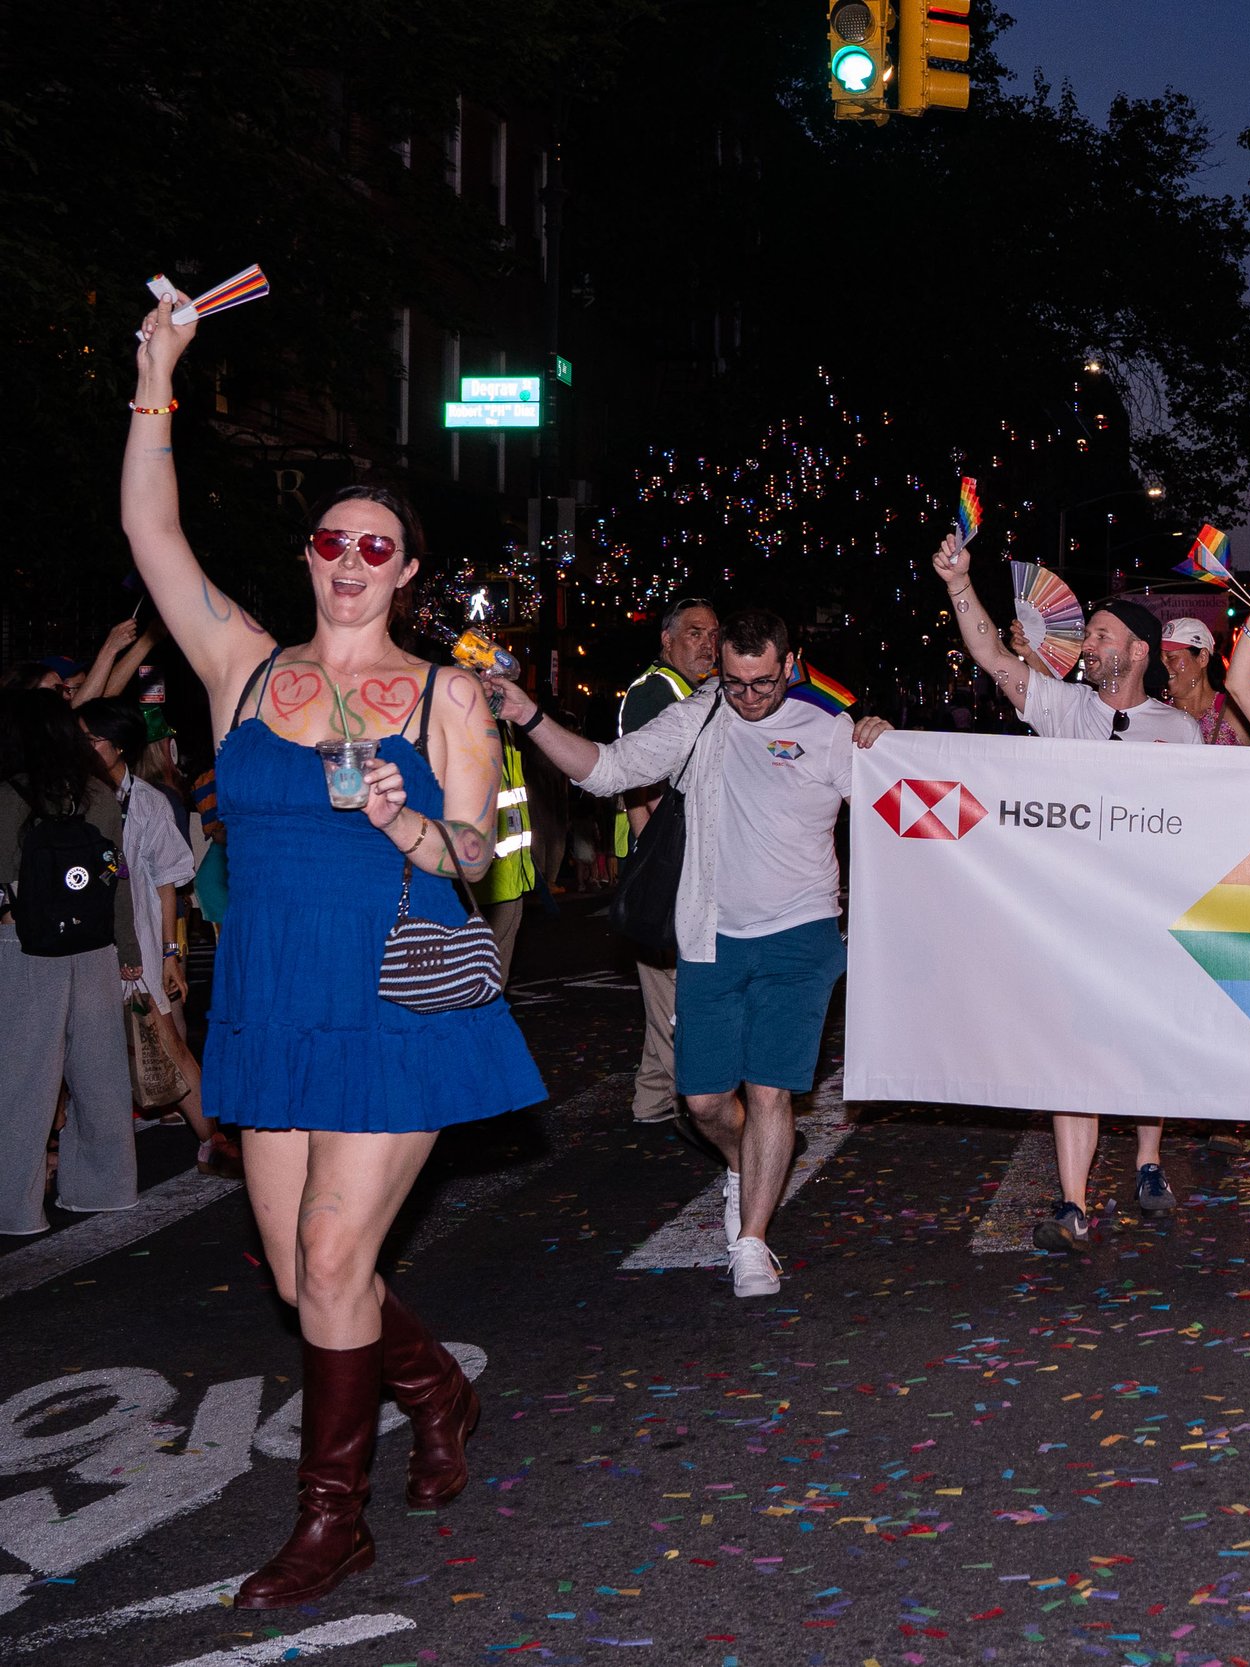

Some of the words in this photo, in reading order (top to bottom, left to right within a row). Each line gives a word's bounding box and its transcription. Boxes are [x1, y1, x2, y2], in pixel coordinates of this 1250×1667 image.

[471, 380, 518, 401] Degraw
[448, 404, 482, 418] Robert
[1160, 596, 1227, 609] Maimonides
[1160, 609, 1197, 621] Health
[999, 800, 1092, 830] HSBC
[1109, 805, 1183, 835] Pride
